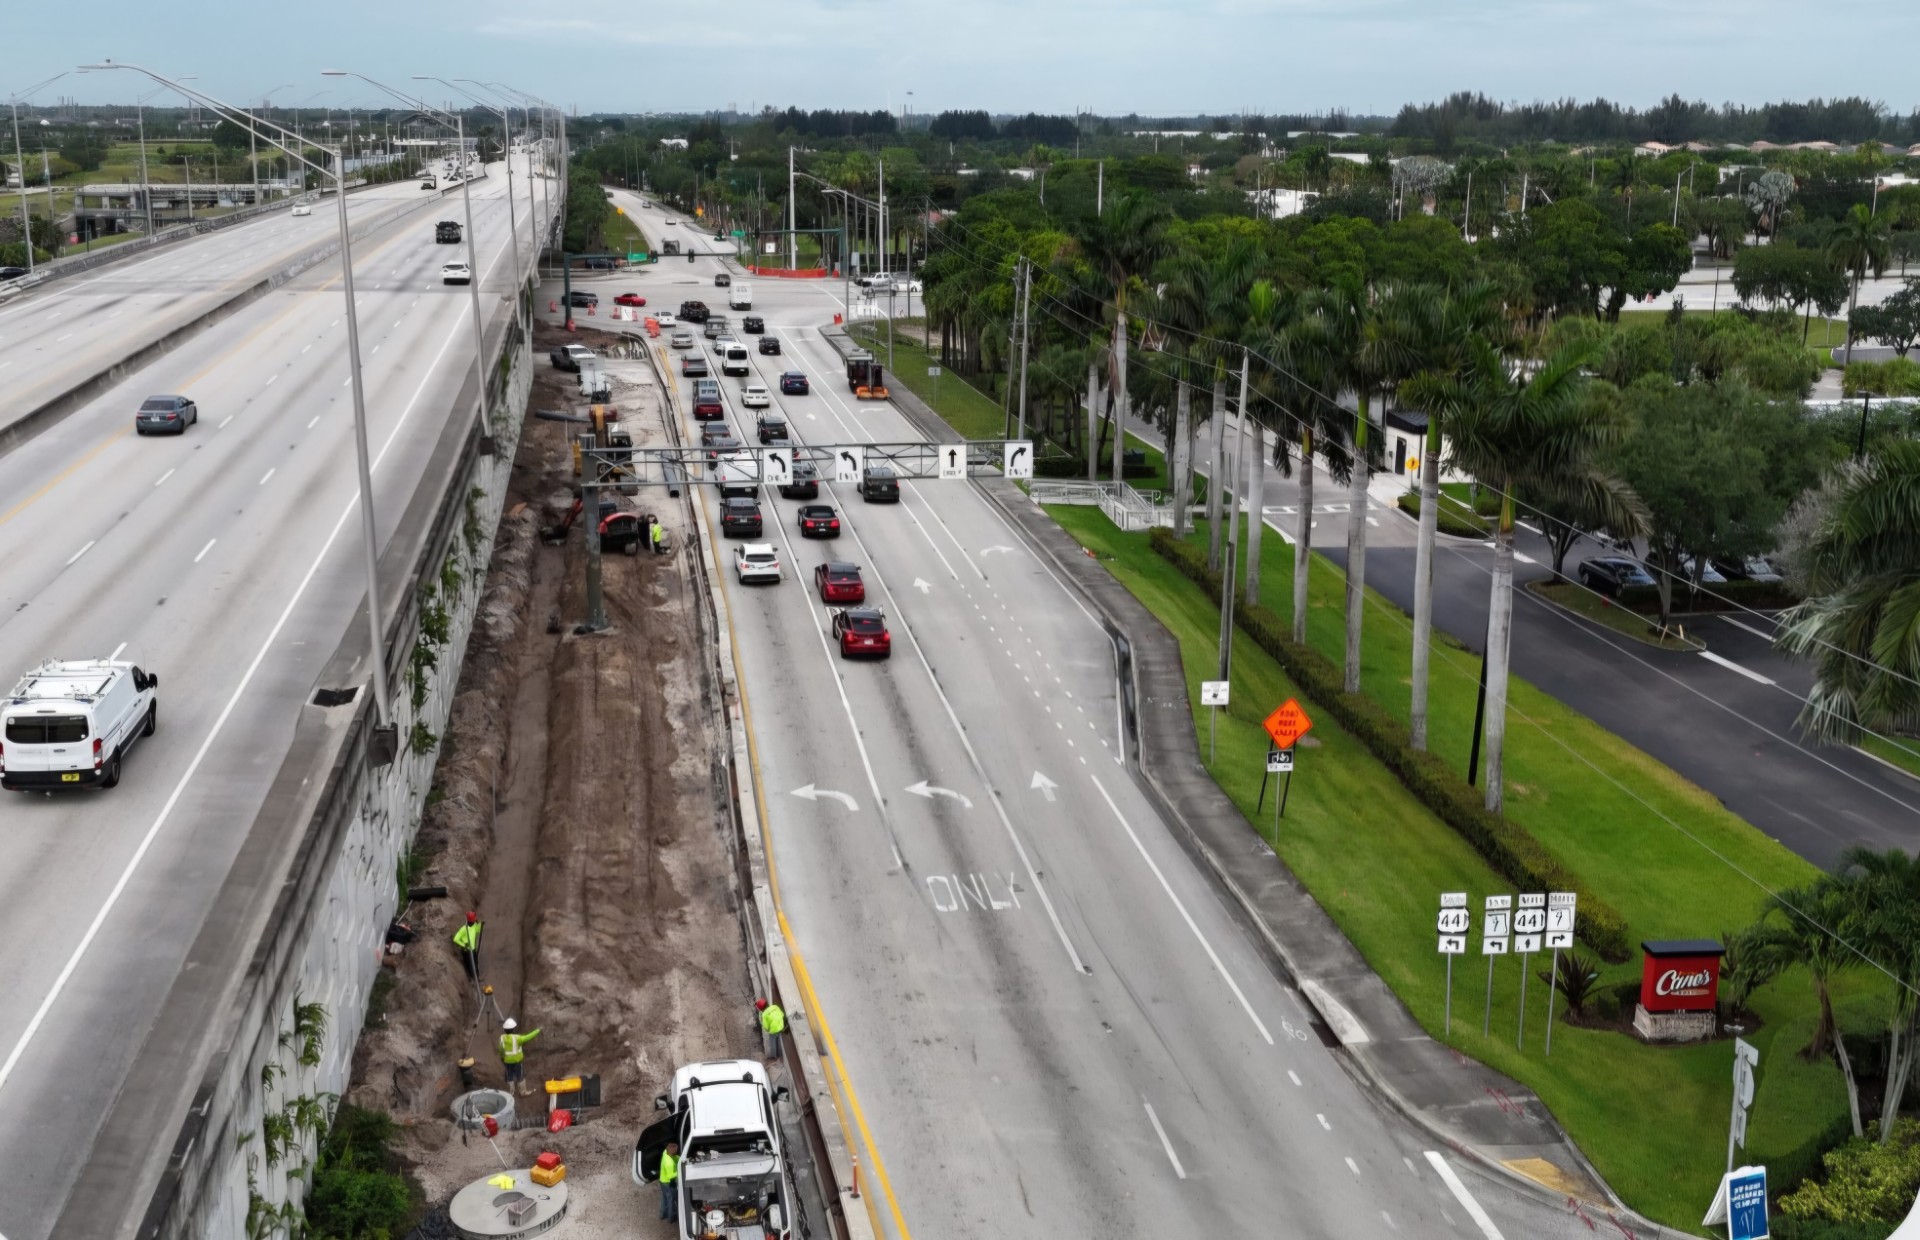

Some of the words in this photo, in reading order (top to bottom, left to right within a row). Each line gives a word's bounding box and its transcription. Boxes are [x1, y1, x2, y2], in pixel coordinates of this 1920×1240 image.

[926, 871, 1021, 912] ONLY
[1441, 913, 1469, 928] 441
[1517, 913, 1544, 928] 441
